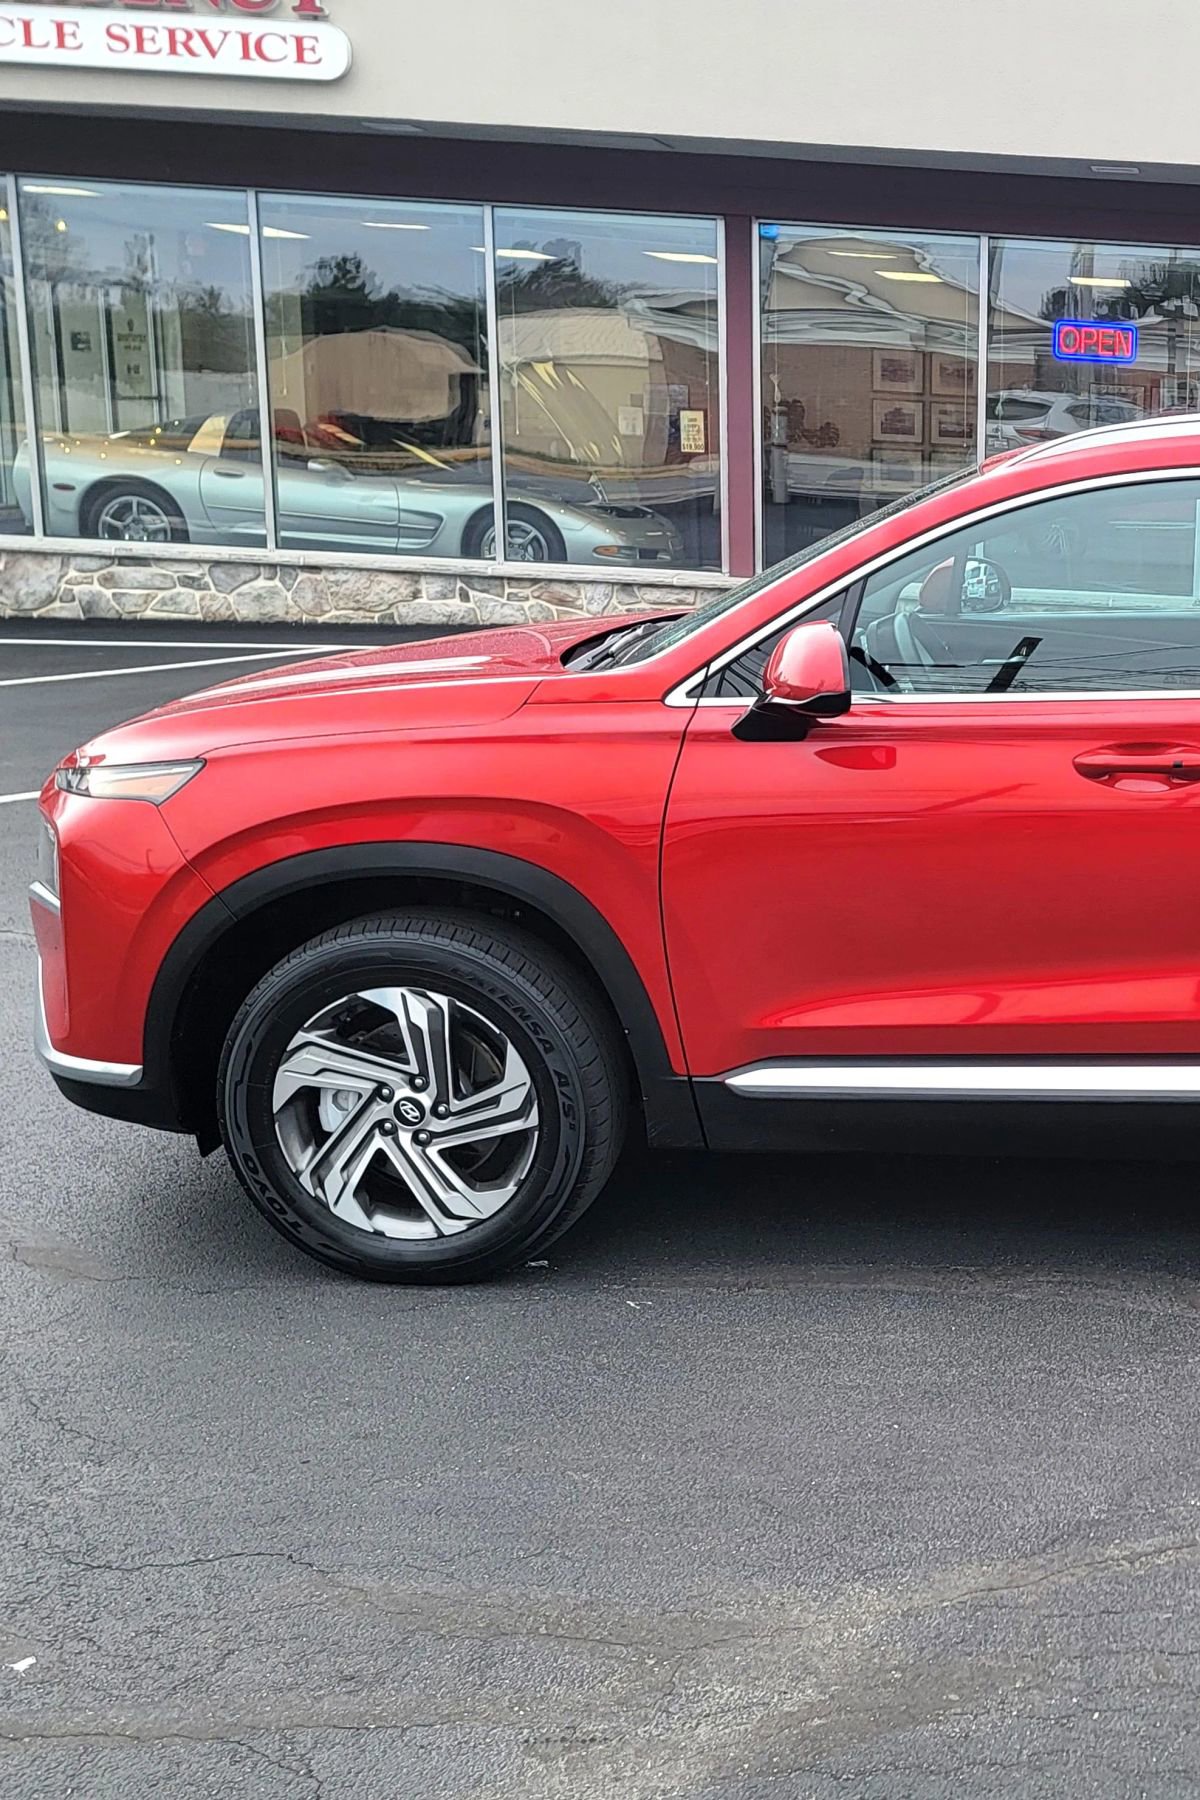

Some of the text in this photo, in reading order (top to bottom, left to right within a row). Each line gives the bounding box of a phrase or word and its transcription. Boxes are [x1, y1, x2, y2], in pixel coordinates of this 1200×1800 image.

[105, 23, 323, 65] SERVICE
[1060, 326, 1133, 357] OPEN
[242, 1152, 302, 1234] TOYO
